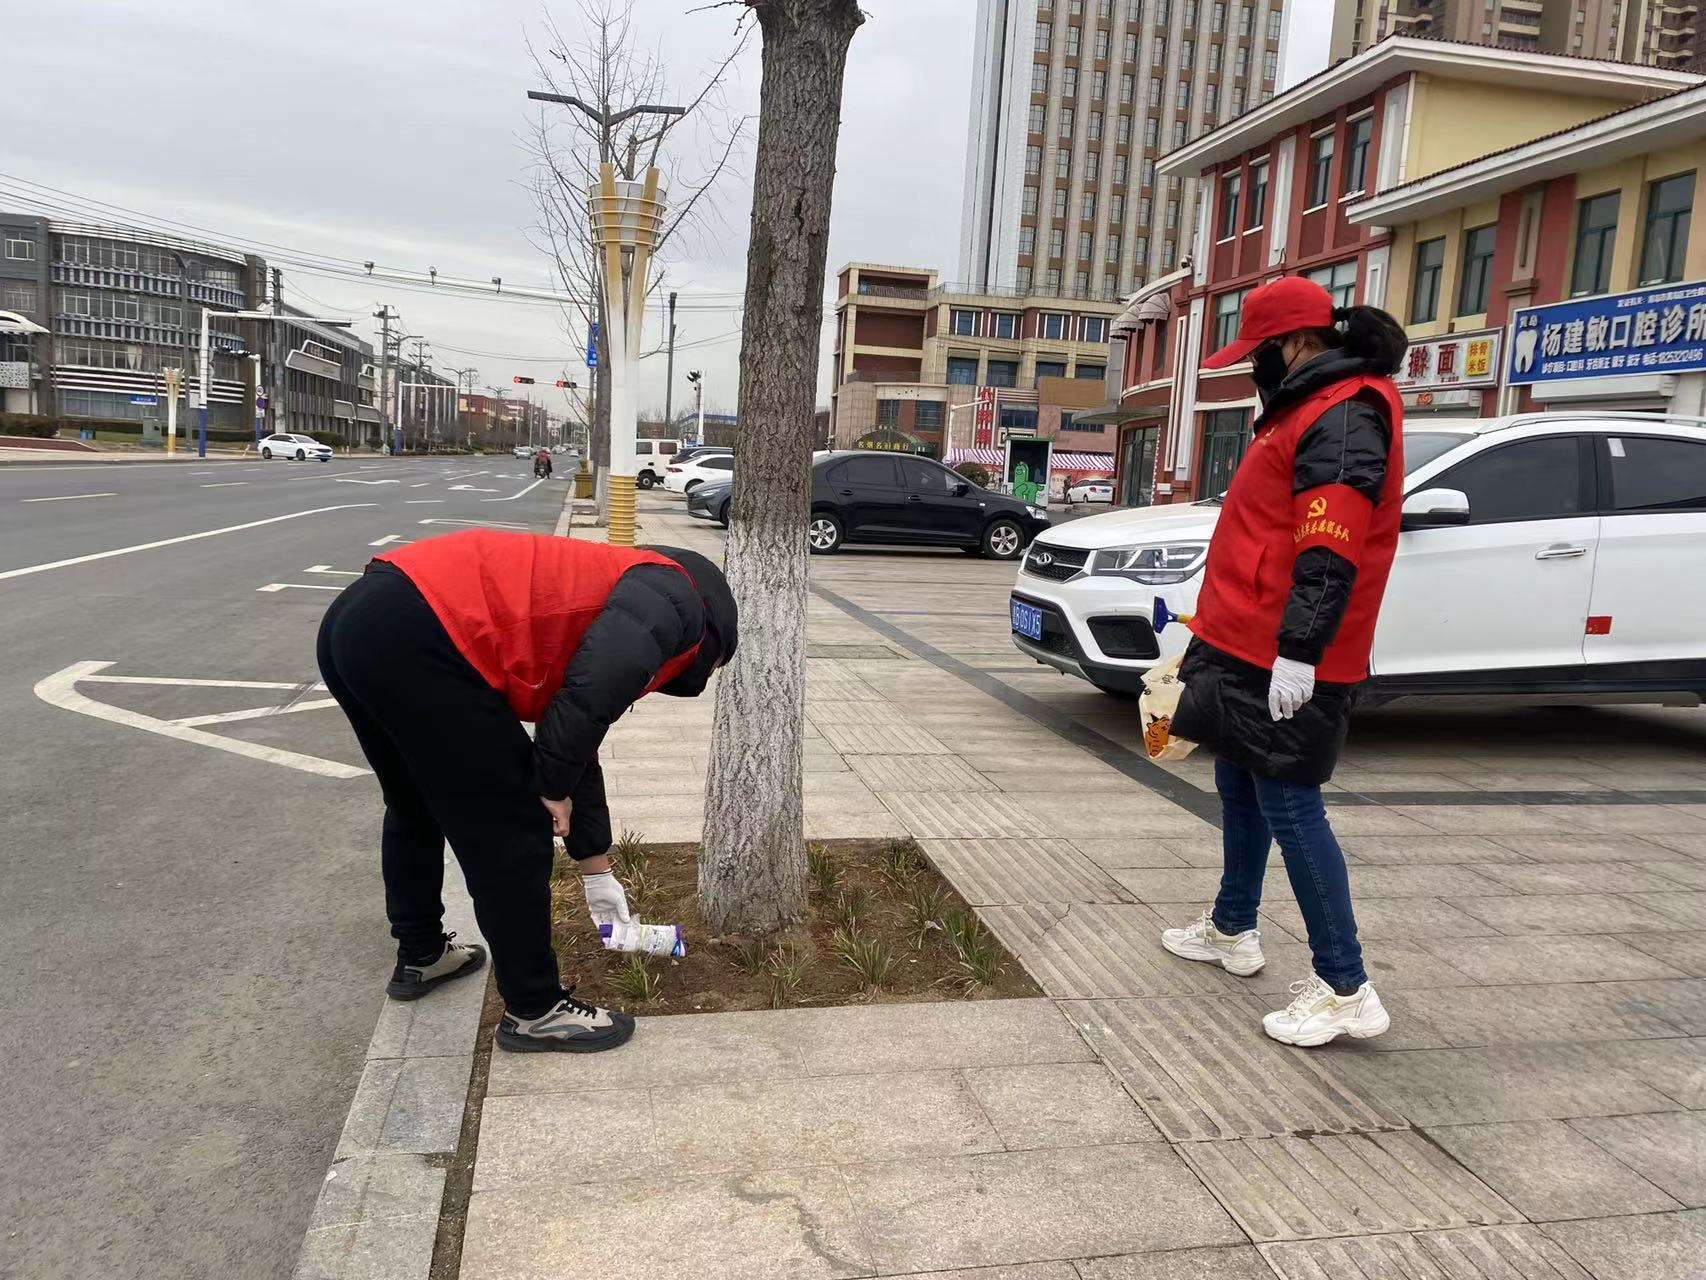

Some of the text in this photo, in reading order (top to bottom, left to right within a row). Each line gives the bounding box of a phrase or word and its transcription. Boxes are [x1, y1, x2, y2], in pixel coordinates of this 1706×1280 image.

[1541, 302, 1706, 358] 杨建敏口腔诊所
